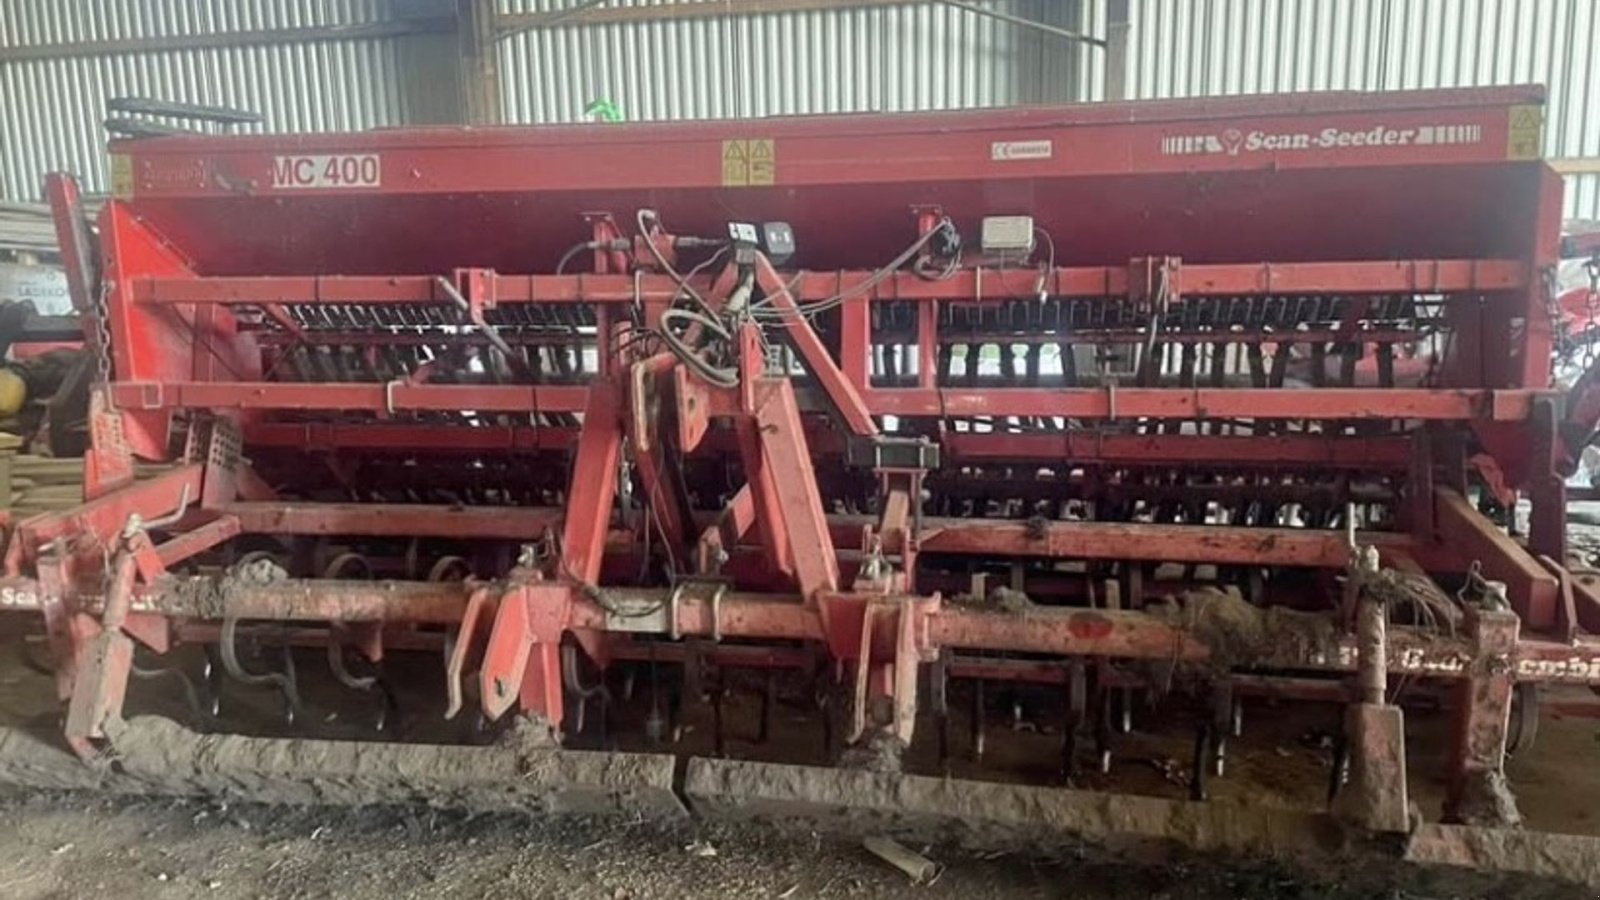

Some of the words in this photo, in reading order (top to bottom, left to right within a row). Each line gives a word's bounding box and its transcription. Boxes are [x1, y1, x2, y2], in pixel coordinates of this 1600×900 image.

[1245, 126, 1416, 151] Scan-Seeder
[272, 158, 315, 186] MC
[323, 156, 377, 185] 400
